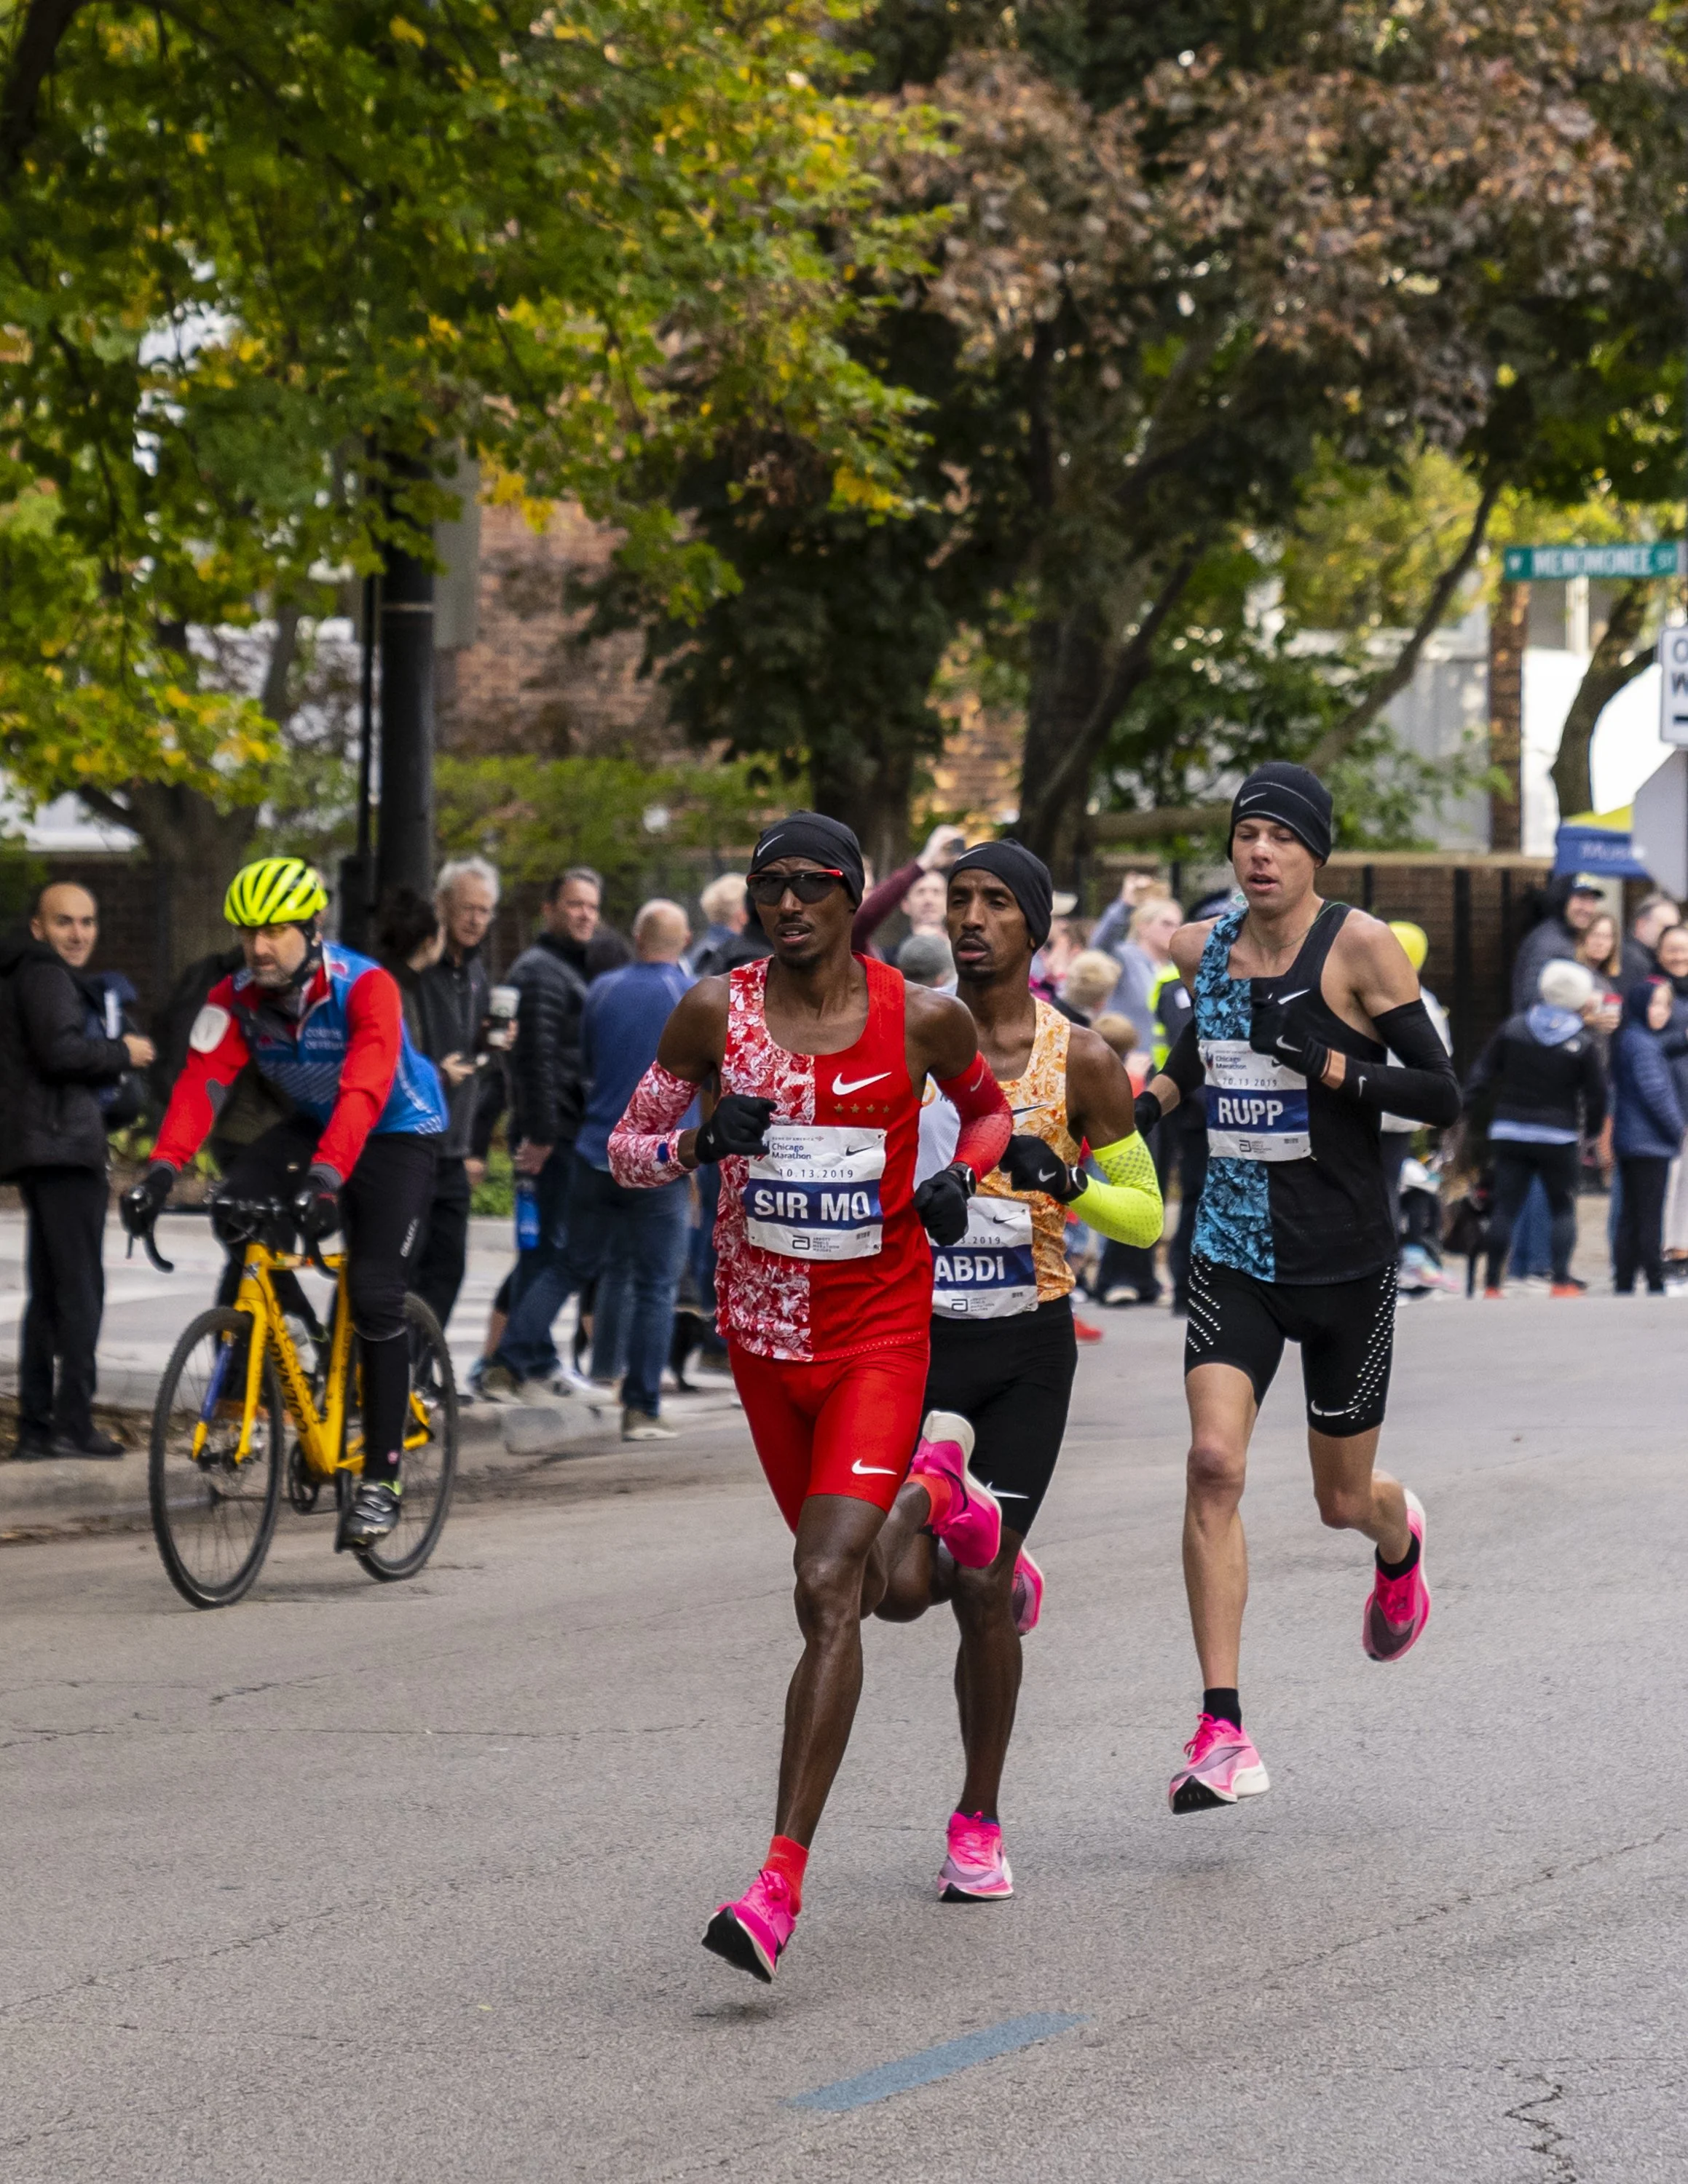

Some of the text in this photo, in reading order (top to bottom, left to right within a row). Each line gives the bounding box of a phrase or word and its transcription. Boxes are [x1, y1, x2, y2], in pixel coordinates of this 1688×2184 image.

[1218, 1097, 1283, 1126] RUPP
[772, 1143, 804, 1152] Chicago
[772, 1152, 811, 1160] Marathon
[778, 1168, 853, 1178] 10.13.2019
[754, 1189, 871, 1221] SIR MO
[934, 1255, 1005, 1282] ABDI
